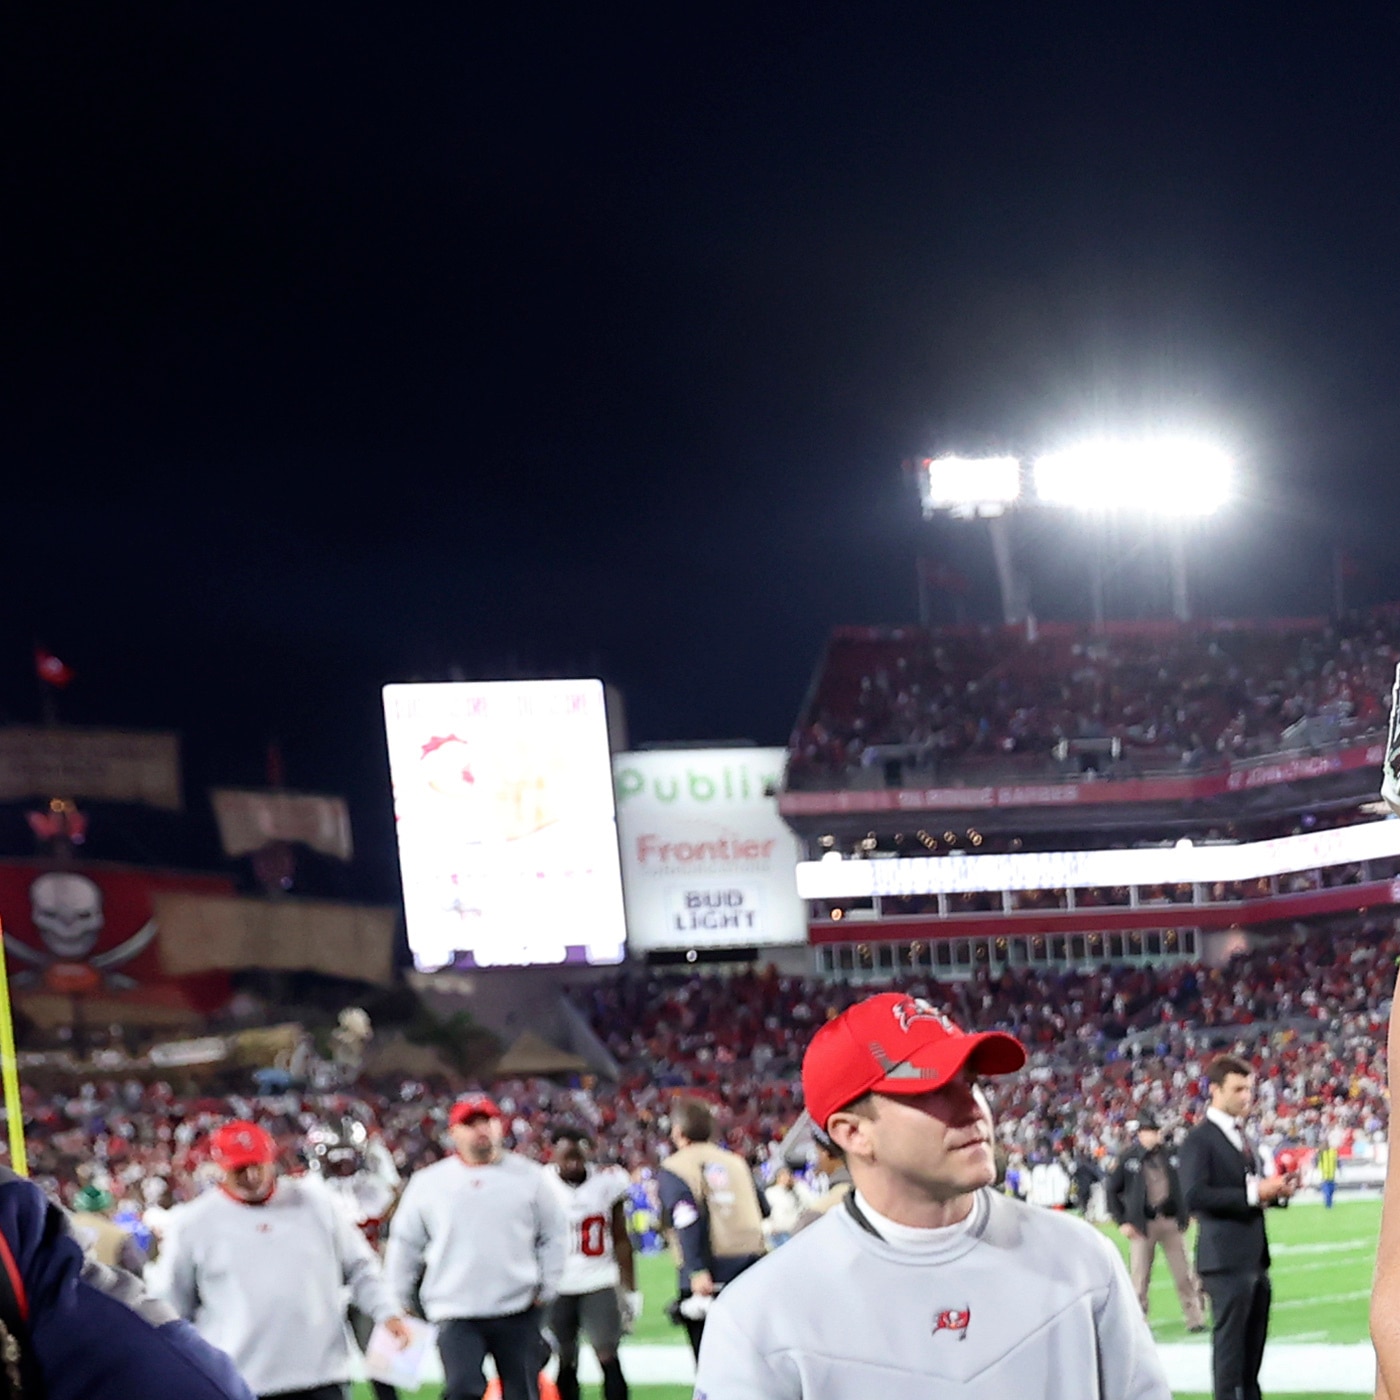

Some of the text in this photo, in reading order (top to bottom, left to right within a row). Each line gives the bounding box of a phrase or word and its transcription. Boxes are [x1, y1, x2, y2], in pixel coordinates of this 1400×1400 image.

[635, 833, 776, 866] Frontier
[684, 889, 745, 910] BUD
[674, 911, 757, 931] LIGHT
